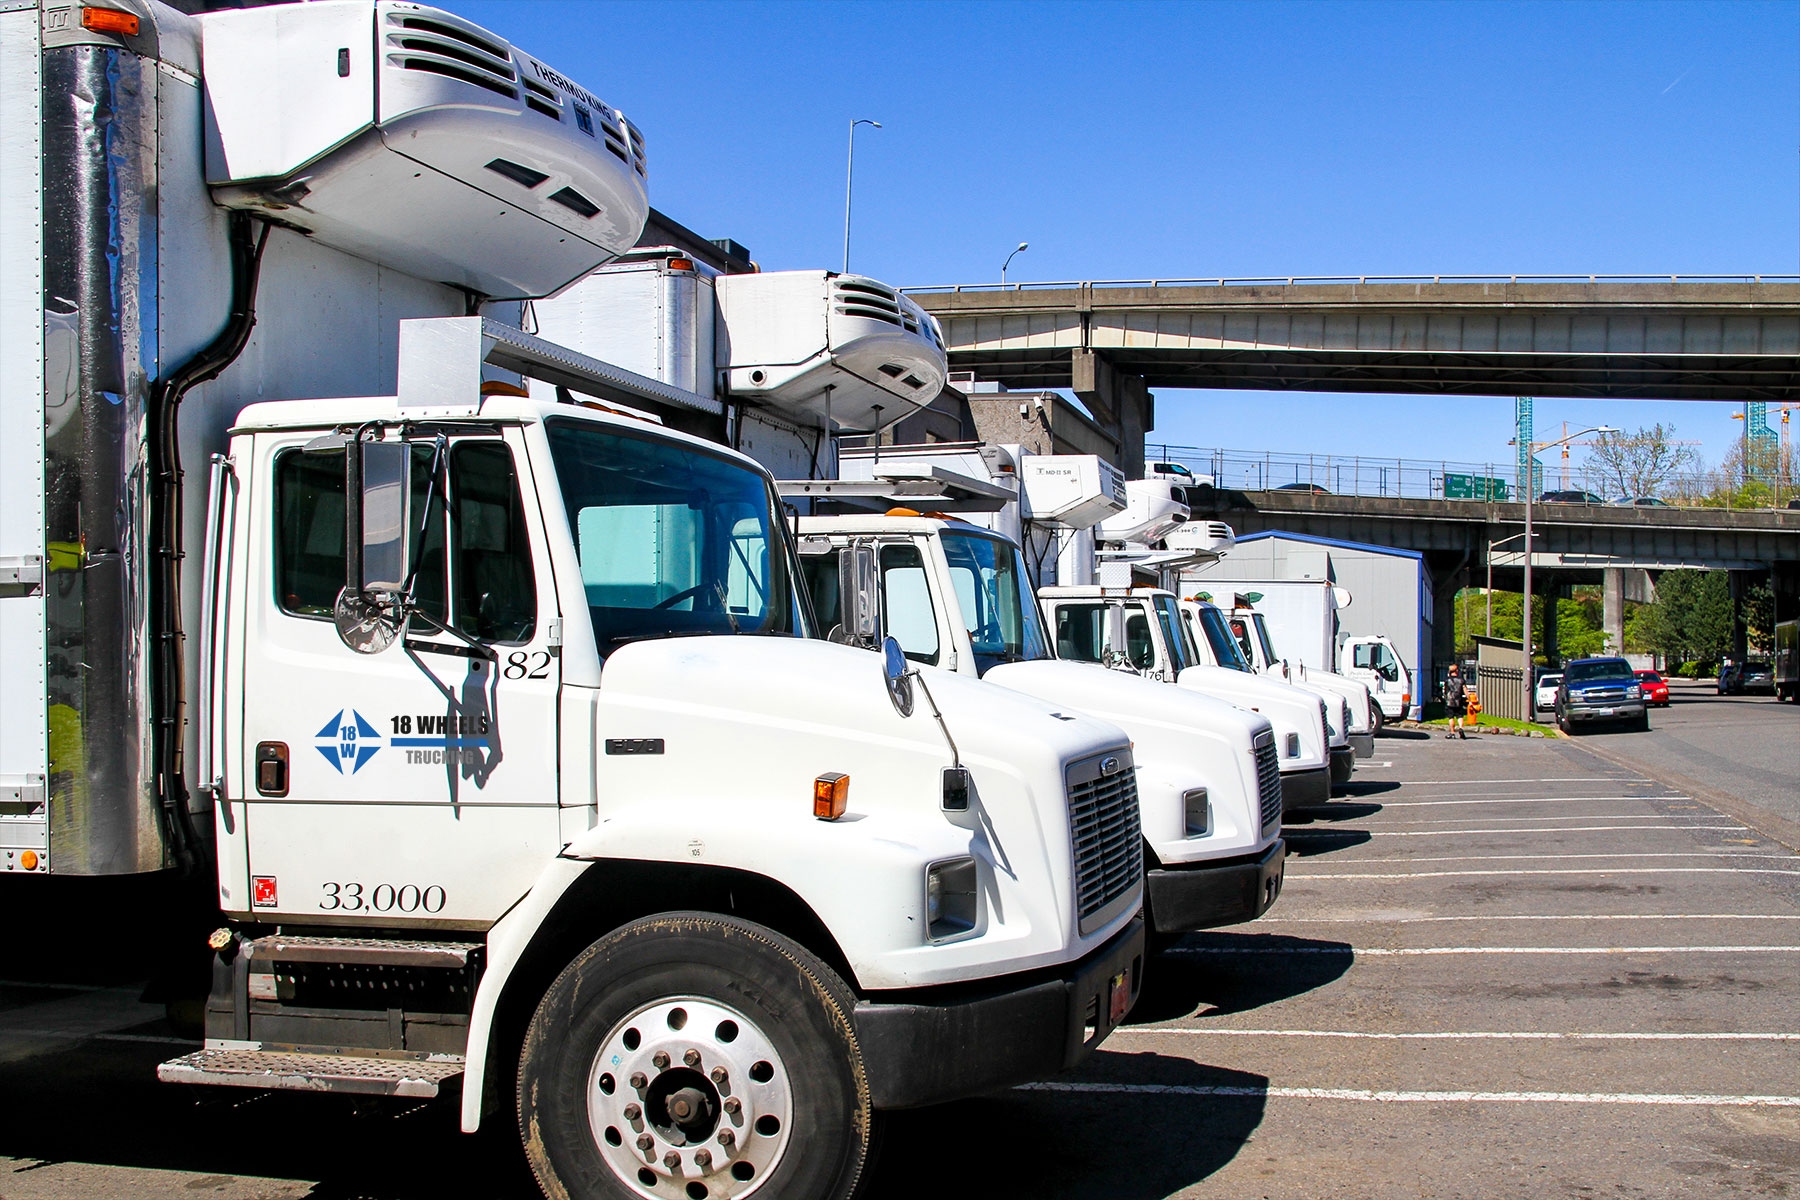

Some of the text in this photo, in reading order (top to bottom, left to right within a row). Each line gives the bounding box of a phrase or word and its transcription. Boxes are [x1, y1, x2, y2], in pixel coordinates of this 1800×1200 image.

[530, 60, 613, 122] THERMO KING
[503, 651, 551, 680] 82
[1149, 671, 1162, 681] 76
[340, 726, 357, 741] 18
[390, 715, 489, 735] 18 WHEELS
[340, 743, 356, 758] W
[406, 750, 474, 765] TRUCKING
[319, 881, 447, 915] 33,000
